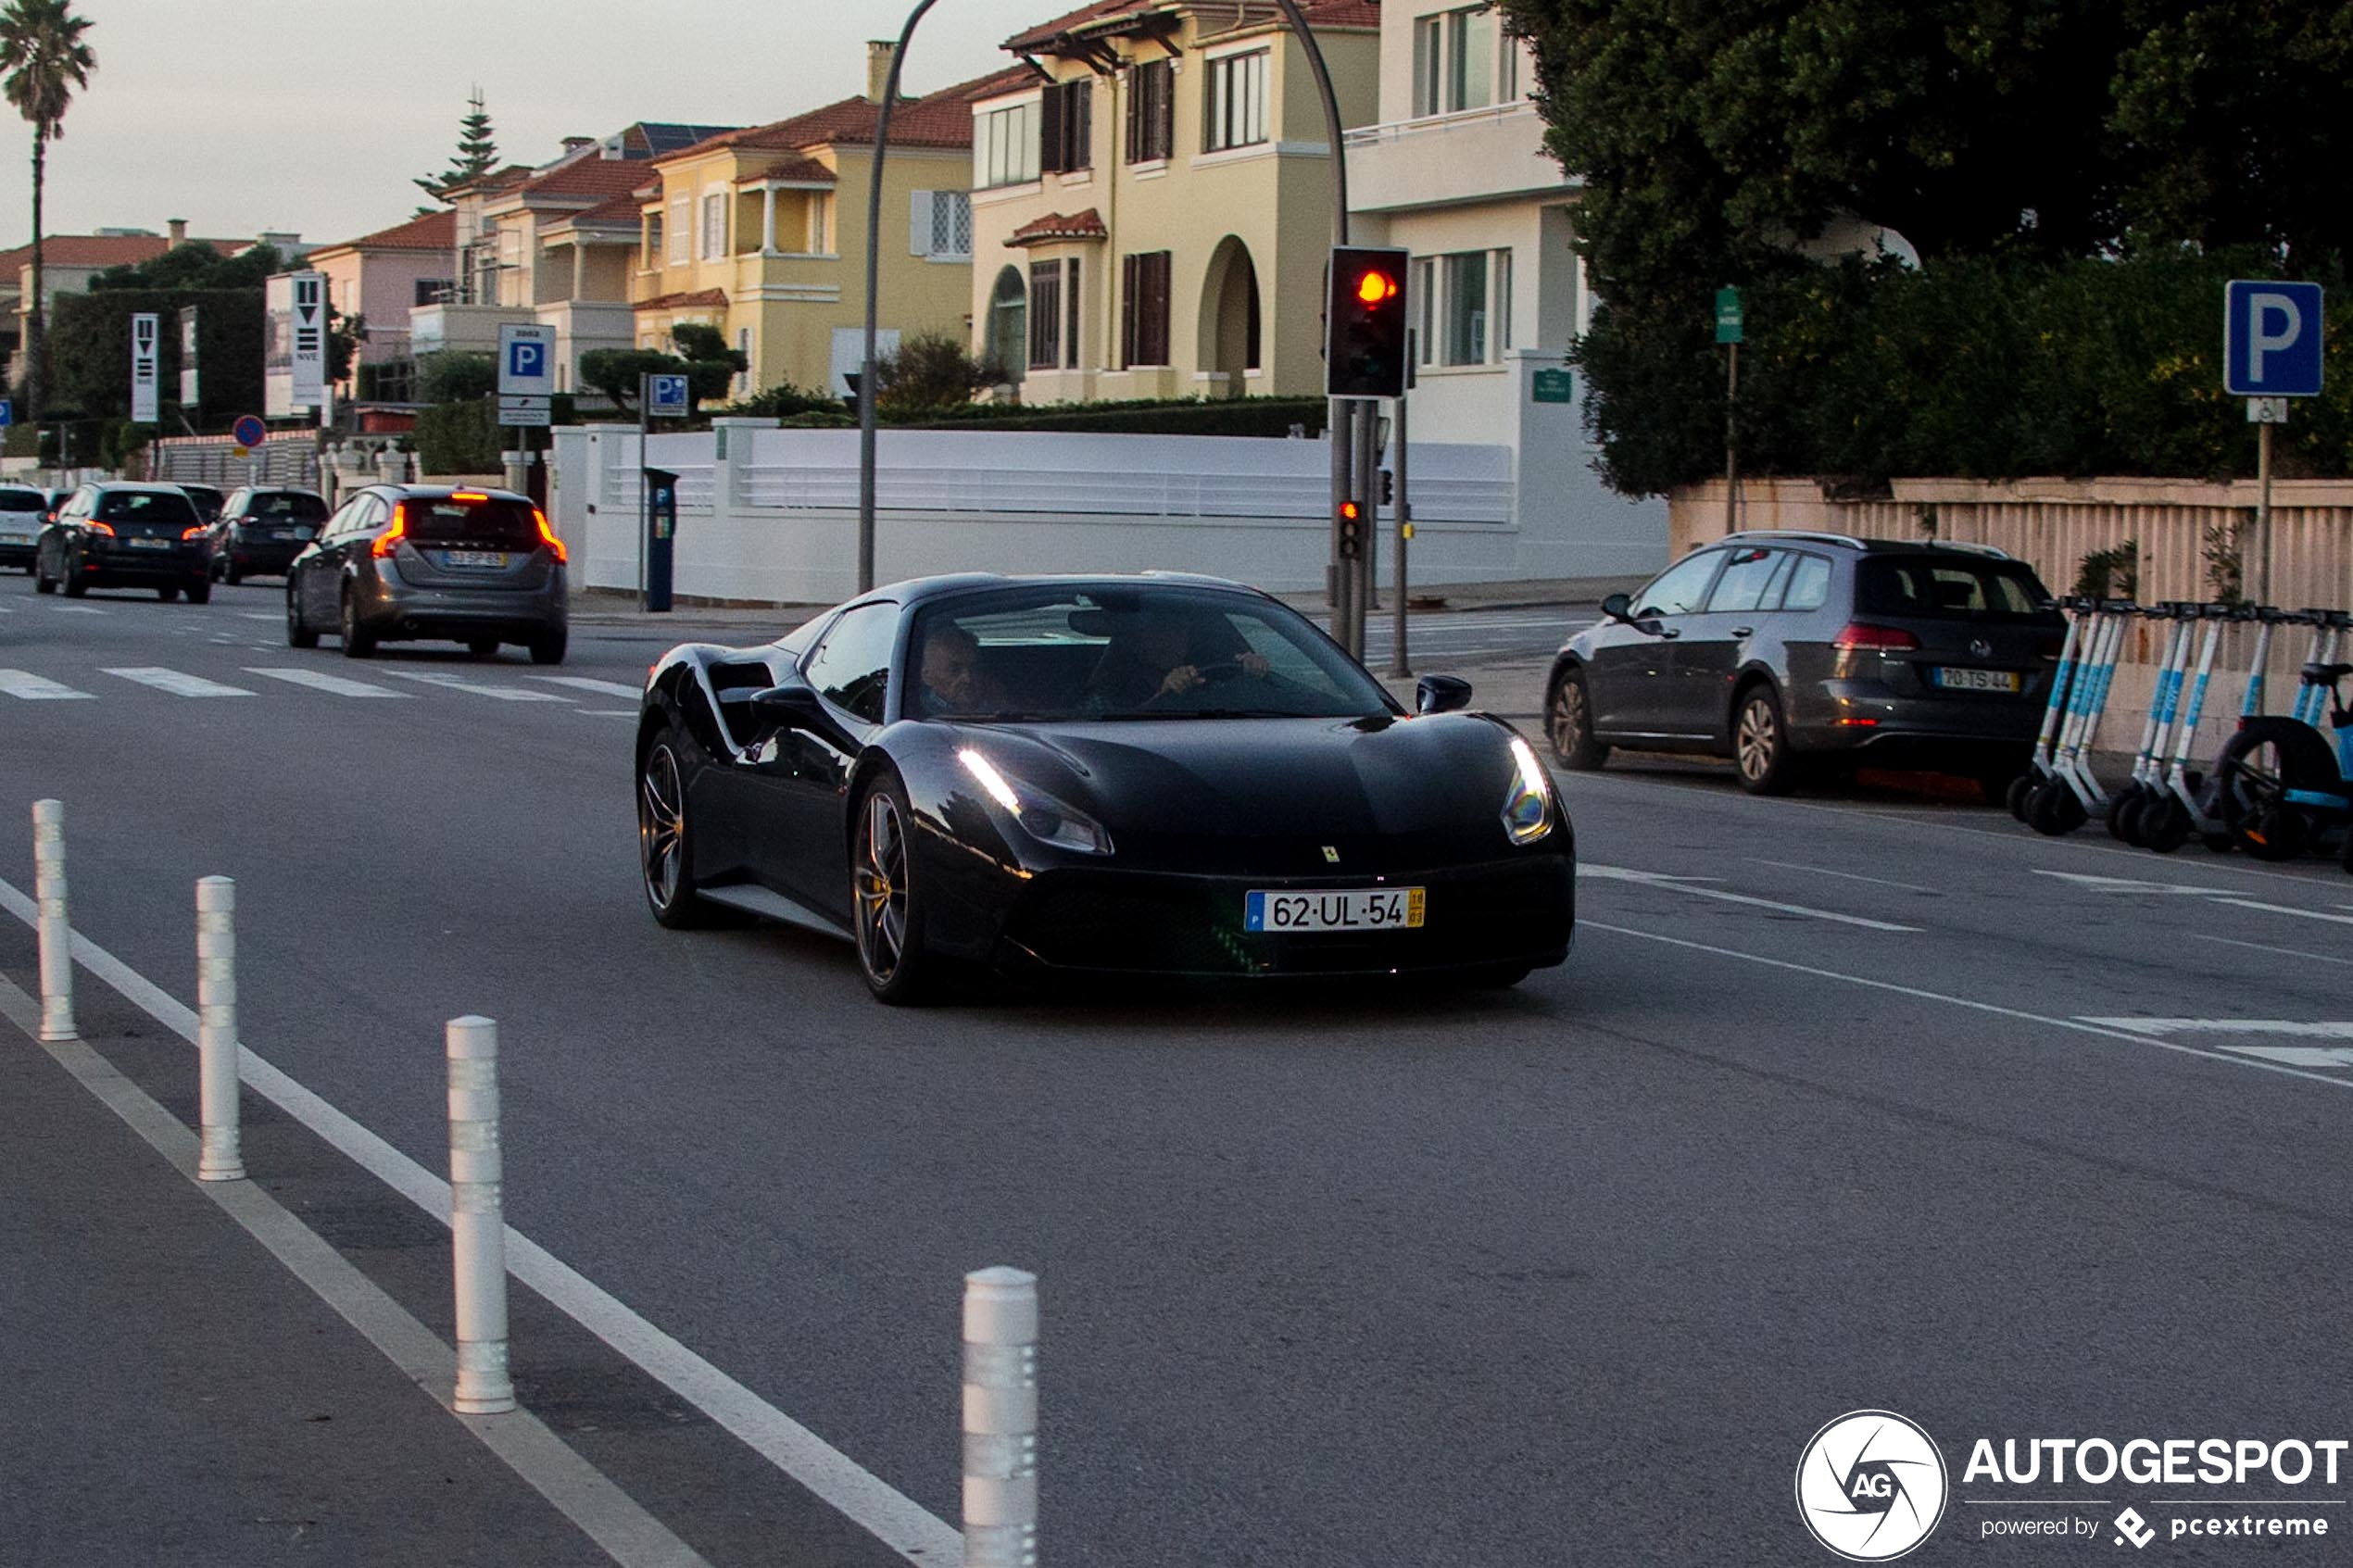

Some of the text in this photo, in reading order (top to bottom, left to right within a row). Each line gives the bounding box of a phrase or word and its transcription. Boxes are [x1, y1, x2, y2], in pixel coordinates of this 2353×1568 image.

[2250, 293, 2301, 383] P
[517, 345, 536, 372] P
[655, 377, 673, 403] P
[656, 488, 668, 502] P
